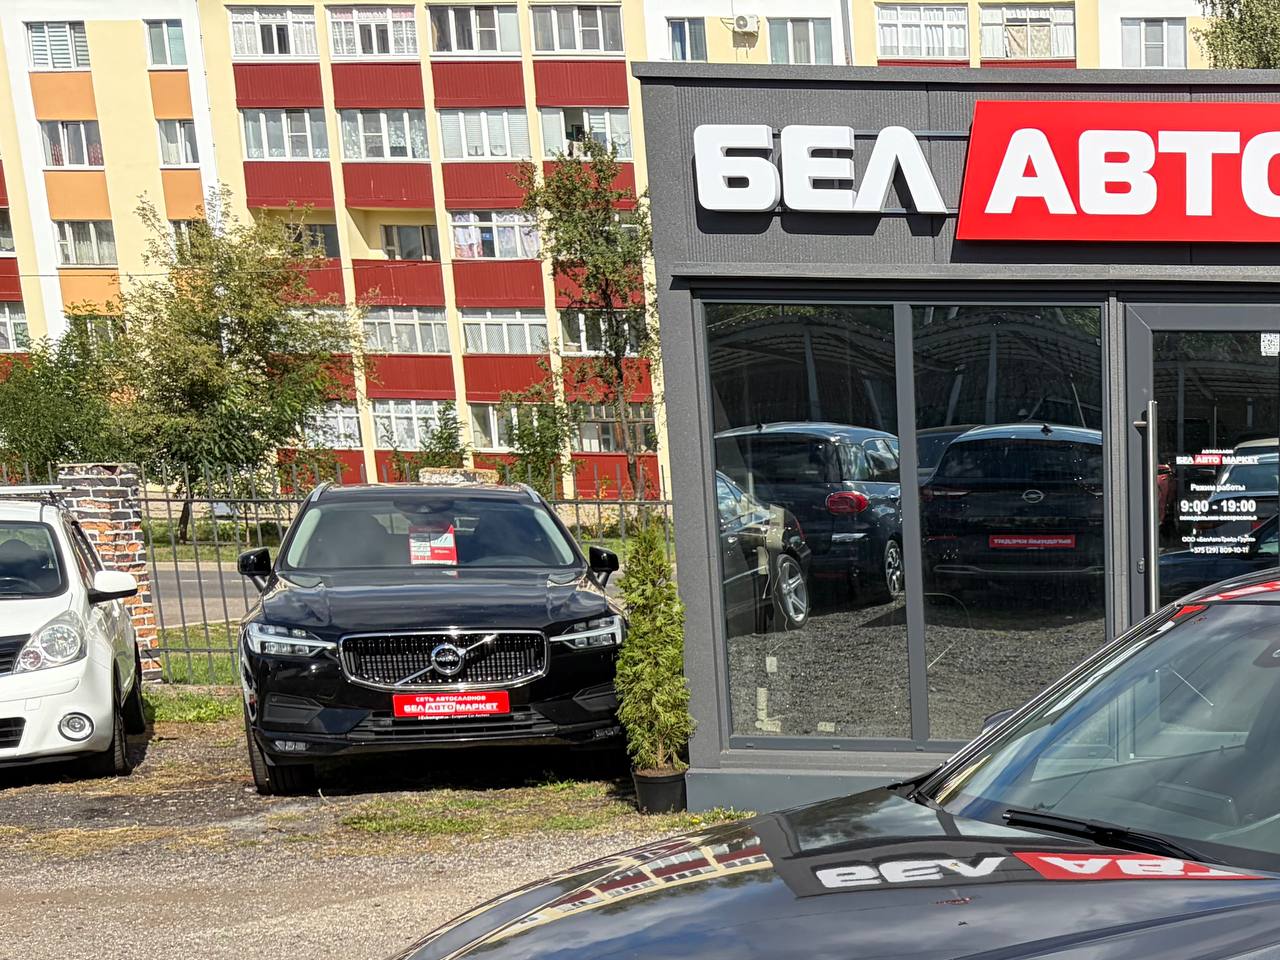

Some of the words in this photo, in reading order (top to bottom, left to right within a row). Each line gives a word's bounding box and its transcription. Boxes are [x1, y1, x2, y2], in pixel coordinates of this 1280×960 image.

[693, 124, 948, 213] БЕЛ
[1195, 456, 1220, 464] АВТО
[1222, 456, 1259, 464] МАРКЕТ
[1190, 483, 1216, 491] Режим
[1217, 483, 1246, 492] работы
[1180, 500, 1209, 512] 9:00
[1221, 500, 1256, 512] 19:00
[1190, 546, 1205, 554] +375
[404, 704, 425, 713] БЕЛ
[427, 703, 454, 712] АВТО
[456, 703, 498, 712] МАРКЕТ
